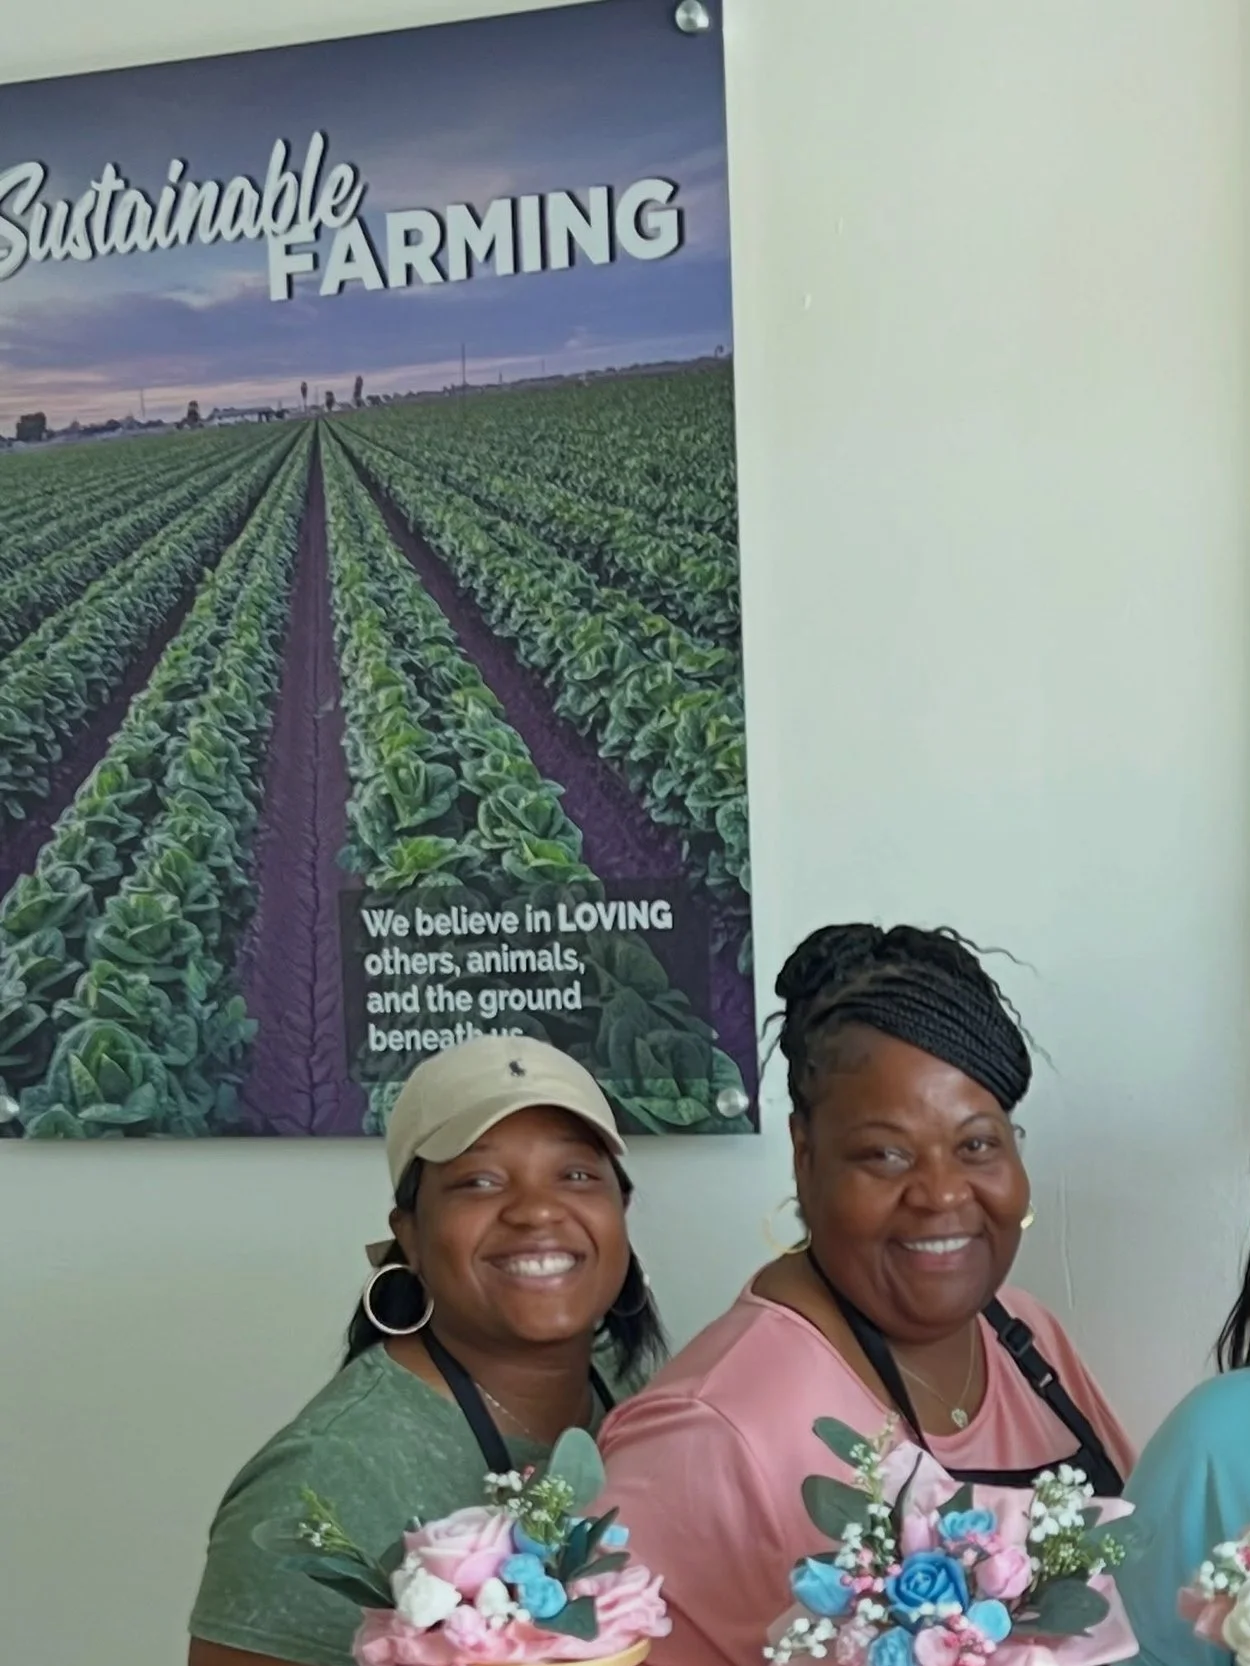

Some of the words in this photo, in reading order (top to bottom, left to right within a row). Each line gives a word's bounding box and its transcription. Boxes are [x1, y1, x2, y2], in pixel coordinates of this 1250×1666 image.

[0, 131, 360, 281] Sustainable
[268, 178, 682, 301] FARMING
[361, 909, 409, 937] We
[415, 906, 519, 936] believe
[526, 903, 552, 933] in
[558, 900, 673, 932] LOVING
[364, 948, 461, 978] others,
[466, 942, 586, 974] animals,
[366, 986, 420, 1014] and
[427, 984, 473, 1012] the
[479, 981, 582, 1018] ground
